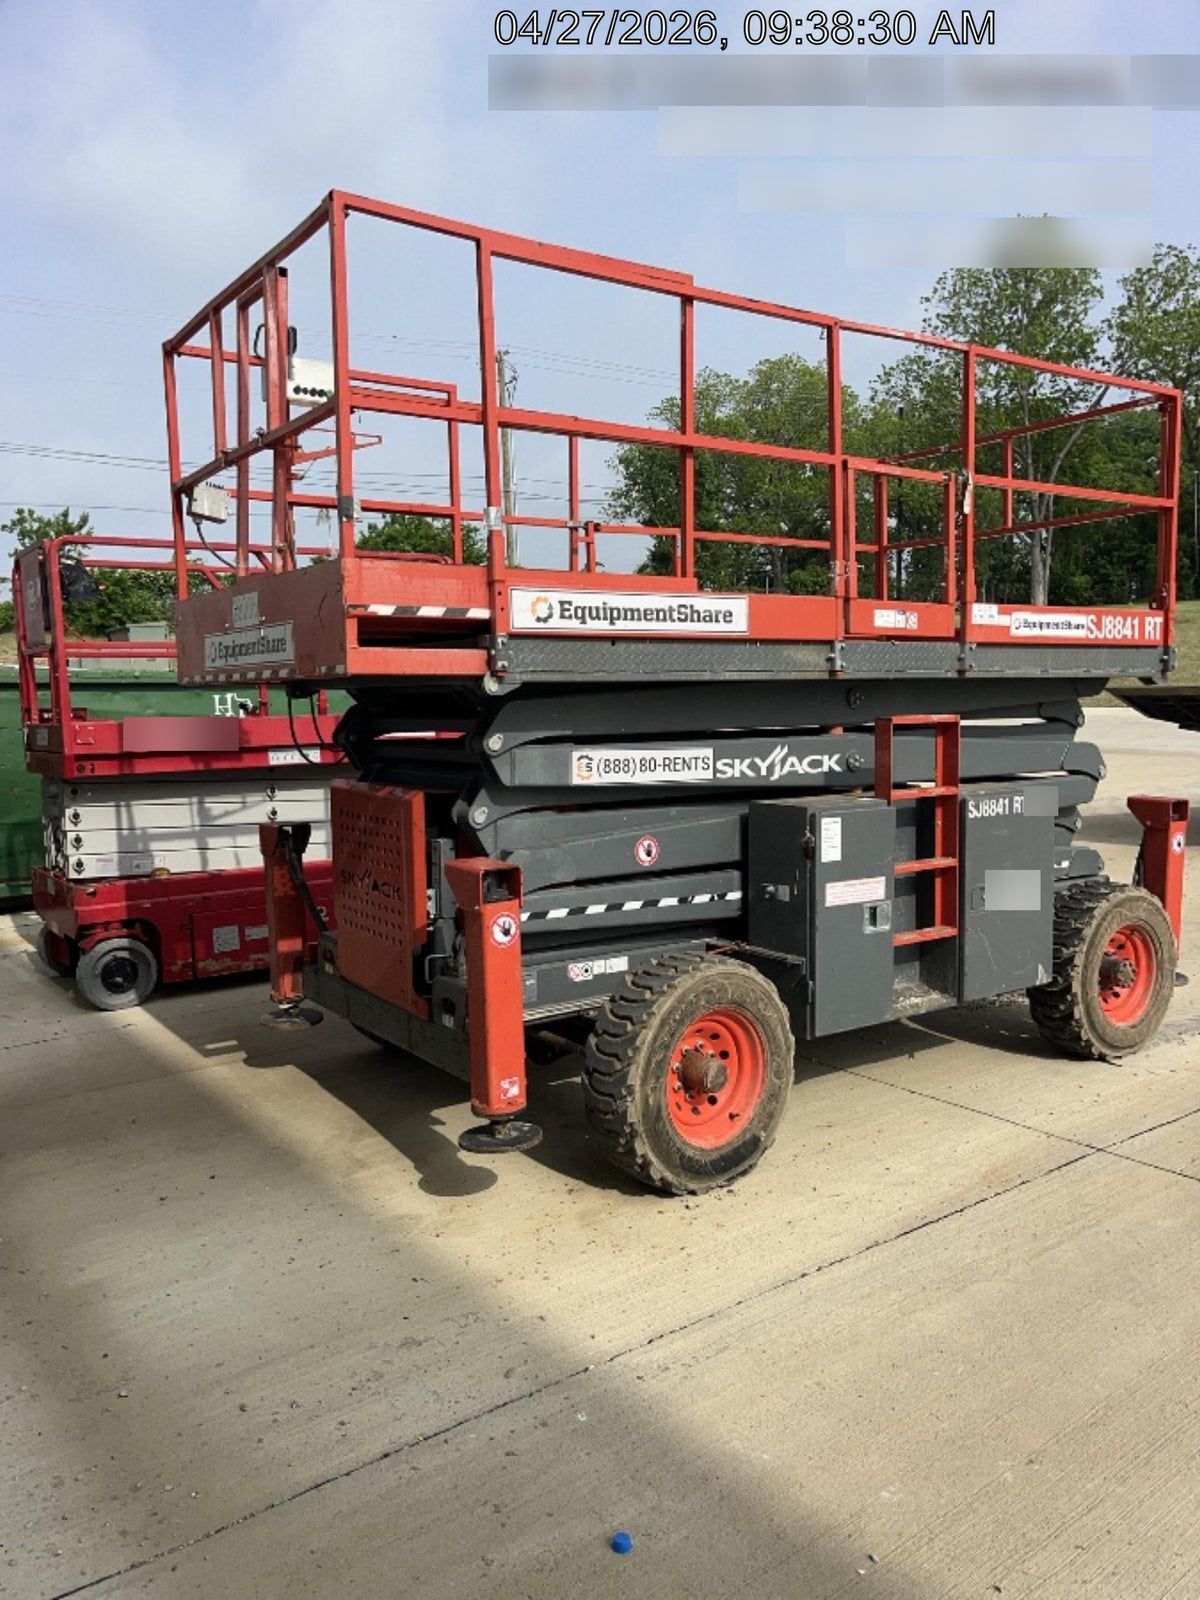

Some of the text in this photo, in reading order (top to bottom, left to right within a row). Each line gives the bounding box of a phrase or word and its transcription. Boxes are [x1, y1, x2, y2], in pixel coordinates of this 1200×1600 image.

[558, 600, 734, 626] EquipmentShare
[1087, 615, 1163, 639] SJ8841 RT
[716, 744, 843, 781] SKYJACK
[968, 797, 1009, 818] SJ8841
